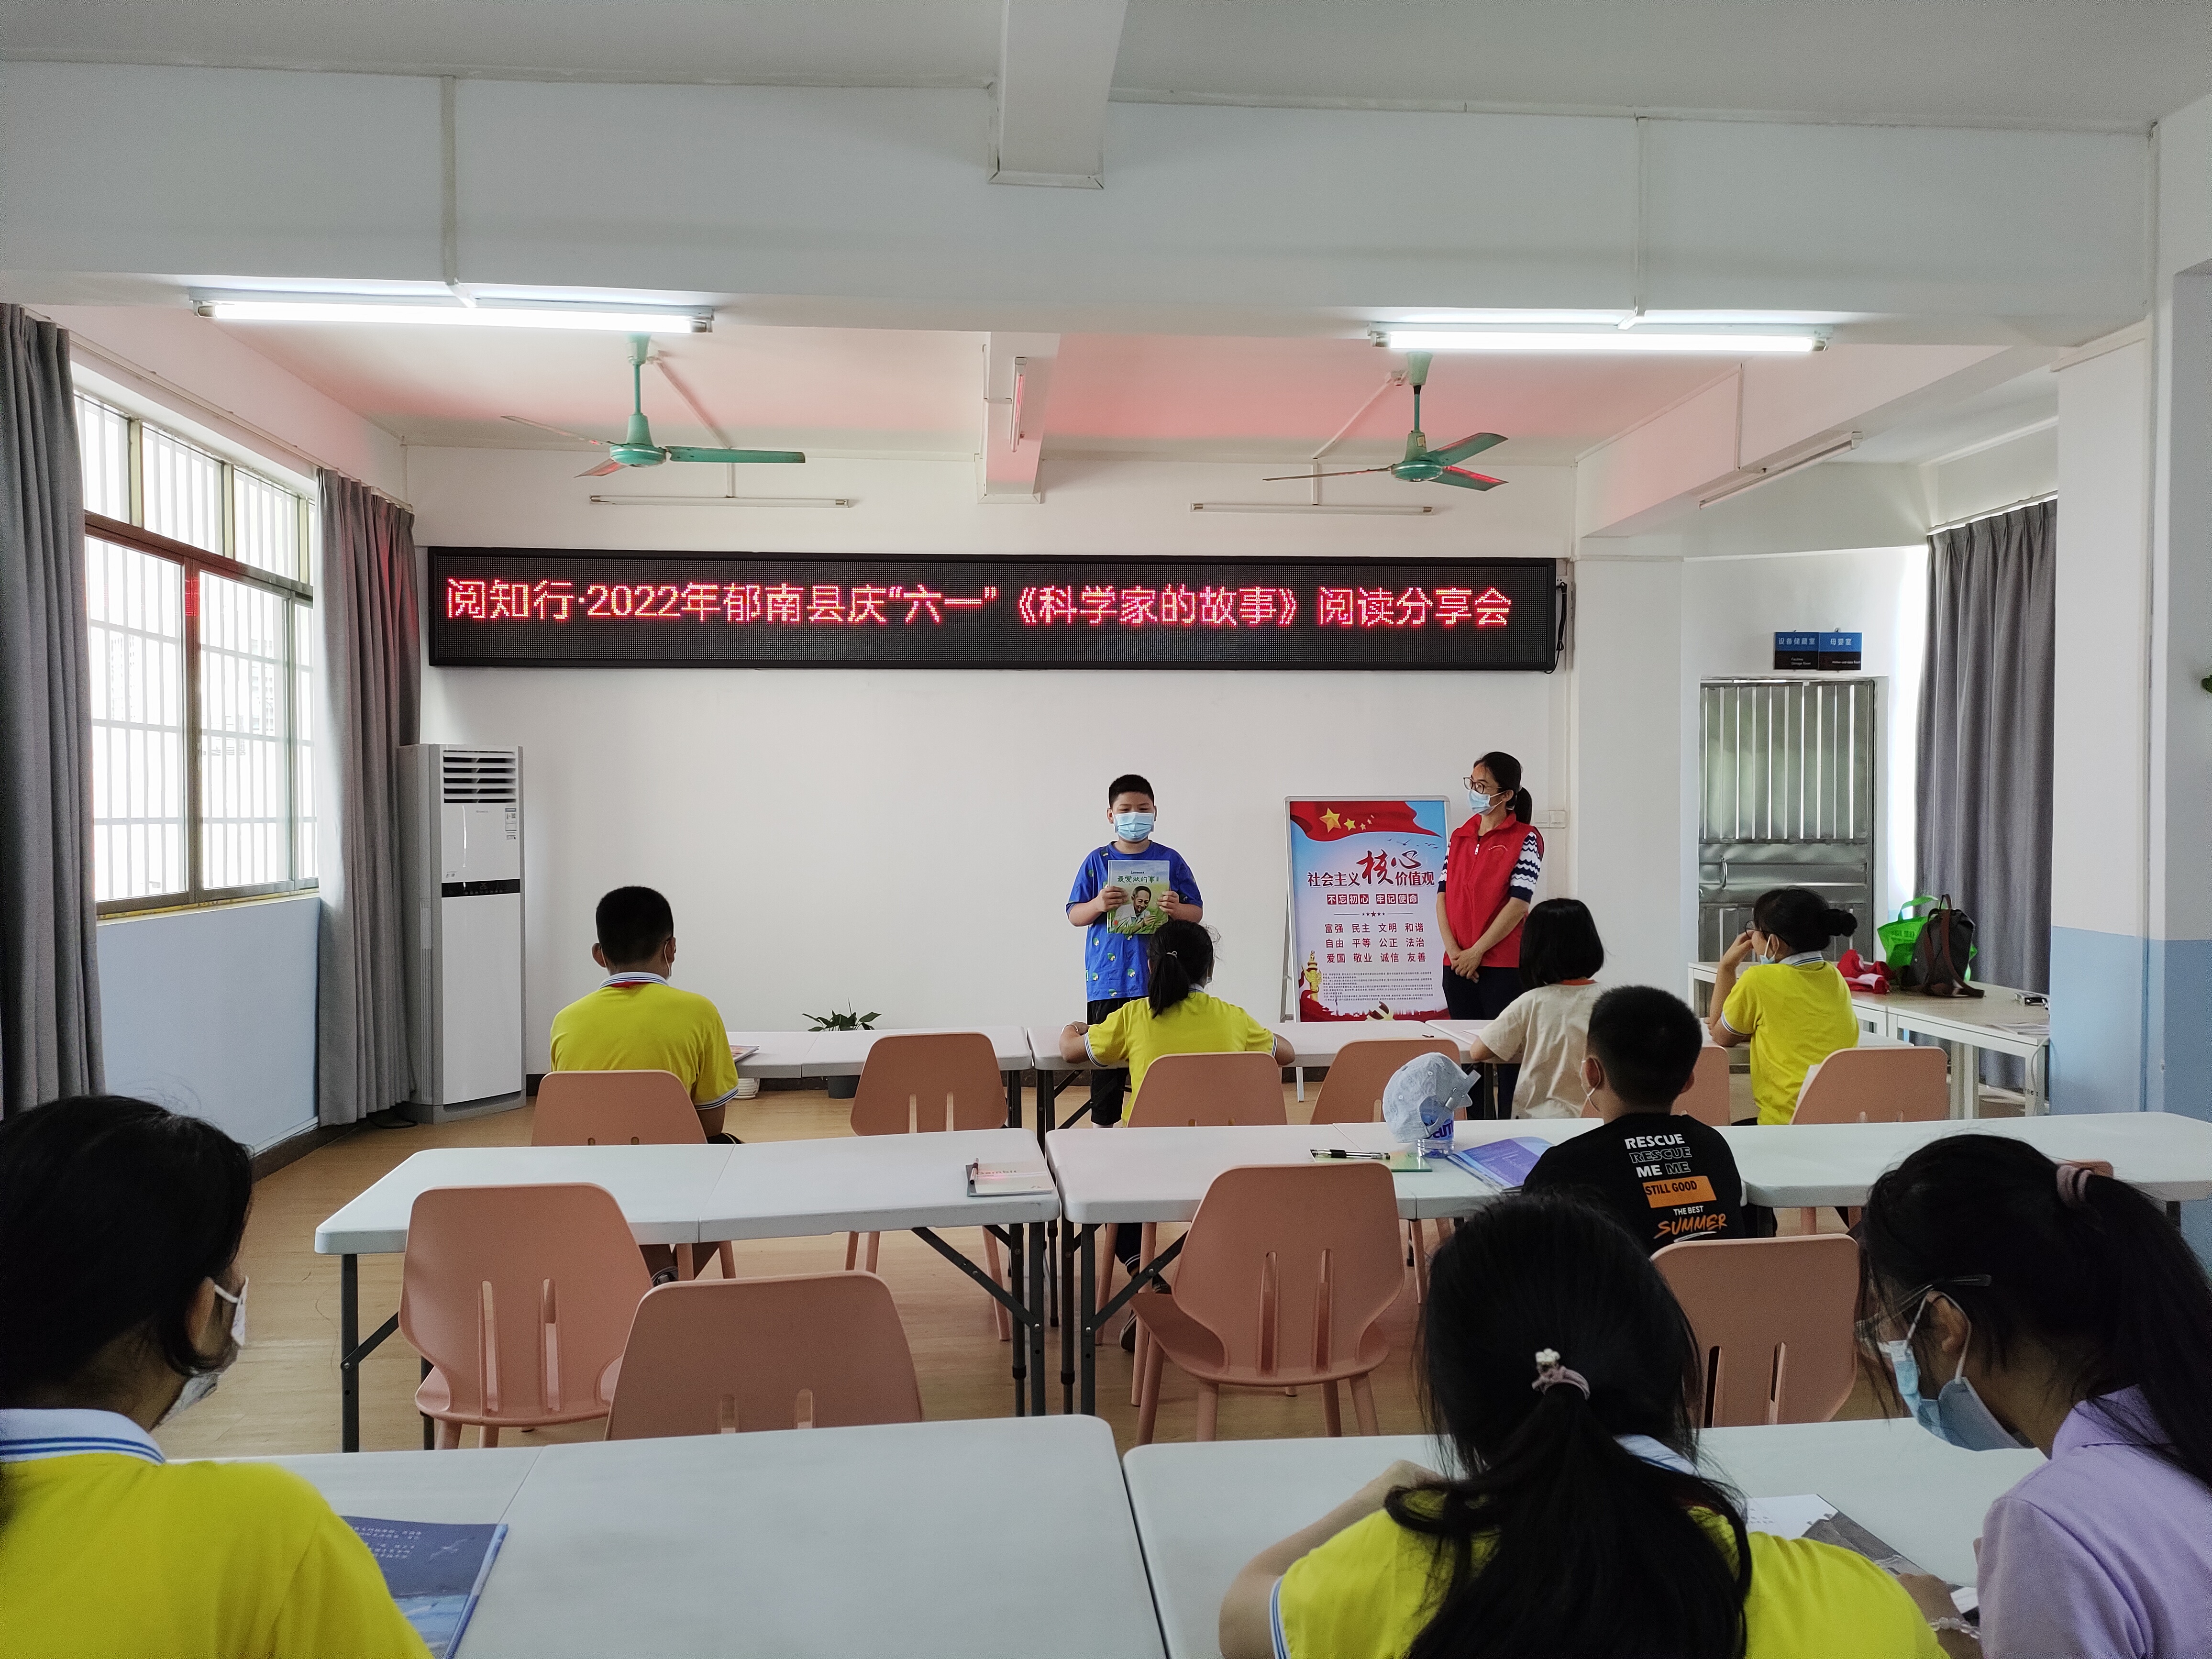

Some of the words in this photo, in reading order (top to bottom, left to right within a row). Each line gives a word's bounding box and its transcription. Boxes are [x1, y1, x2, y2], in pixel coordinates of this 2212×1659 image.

[1830, 638, 1852, 646] 母婴室
[1327, 895, 1369, 905] 不忘初心
[1376, 894, 1418, 904] 牢记使命
[1325, 924, 1344, 933] 富强
[1352, 924, 1371, 933] 民主
[1378, 923, 1397, 933] 文明
[1405, 923, 1424, 933] 和谐
[1326, 939, 1344, 948] 自由
[1352, 938, 1371, 948] 平等
[1379, 938, 1398, 948] 公正
[1405, 938, 1425, 948] 法治
[1327, 953, 1345, 963] 爱国
[1353, 953, 1372, 963] 敬业
[1380, 953, 1399, 962] 诚信
[1407, 952, 1426, 962] 友善
[1625, 1134, 1685, 1149] RESCUE
[1629, 1146, 1692, 1163] RESCUE
[1636, 1165, 1662, 1178] ME
[1665, 1161, 1691, 1174] ME
[1645, 1183, 1670, 1195] STILL
[1672, 1181, 1697, 1192] GOOD
[1688, 1206, 1704, 1214] BEST
[1653, 1213, 1727, 1239] SUMMER
